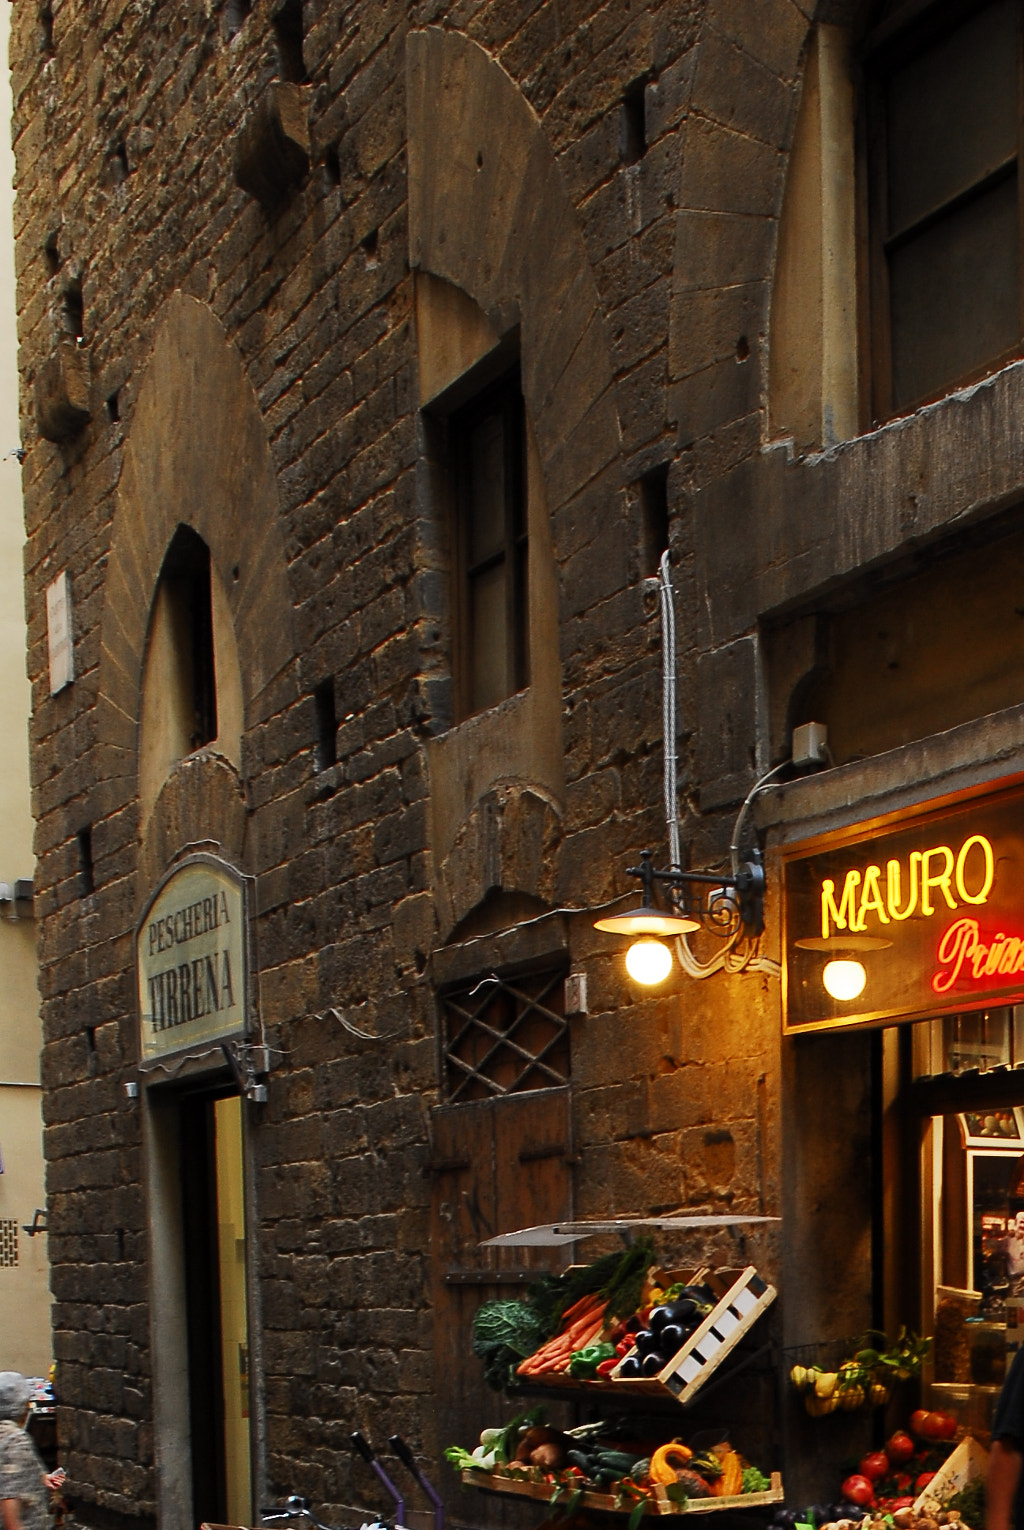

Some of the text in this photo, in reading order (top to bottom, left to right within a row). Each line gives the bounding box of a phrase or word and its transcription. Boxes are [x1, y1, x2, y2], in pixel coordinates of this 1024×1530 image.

[148, 891, 231, 957] PESCHERIA
[822, 835, 994, 939] MAURO
[148, 950, 236, 1034] TIRRENA
